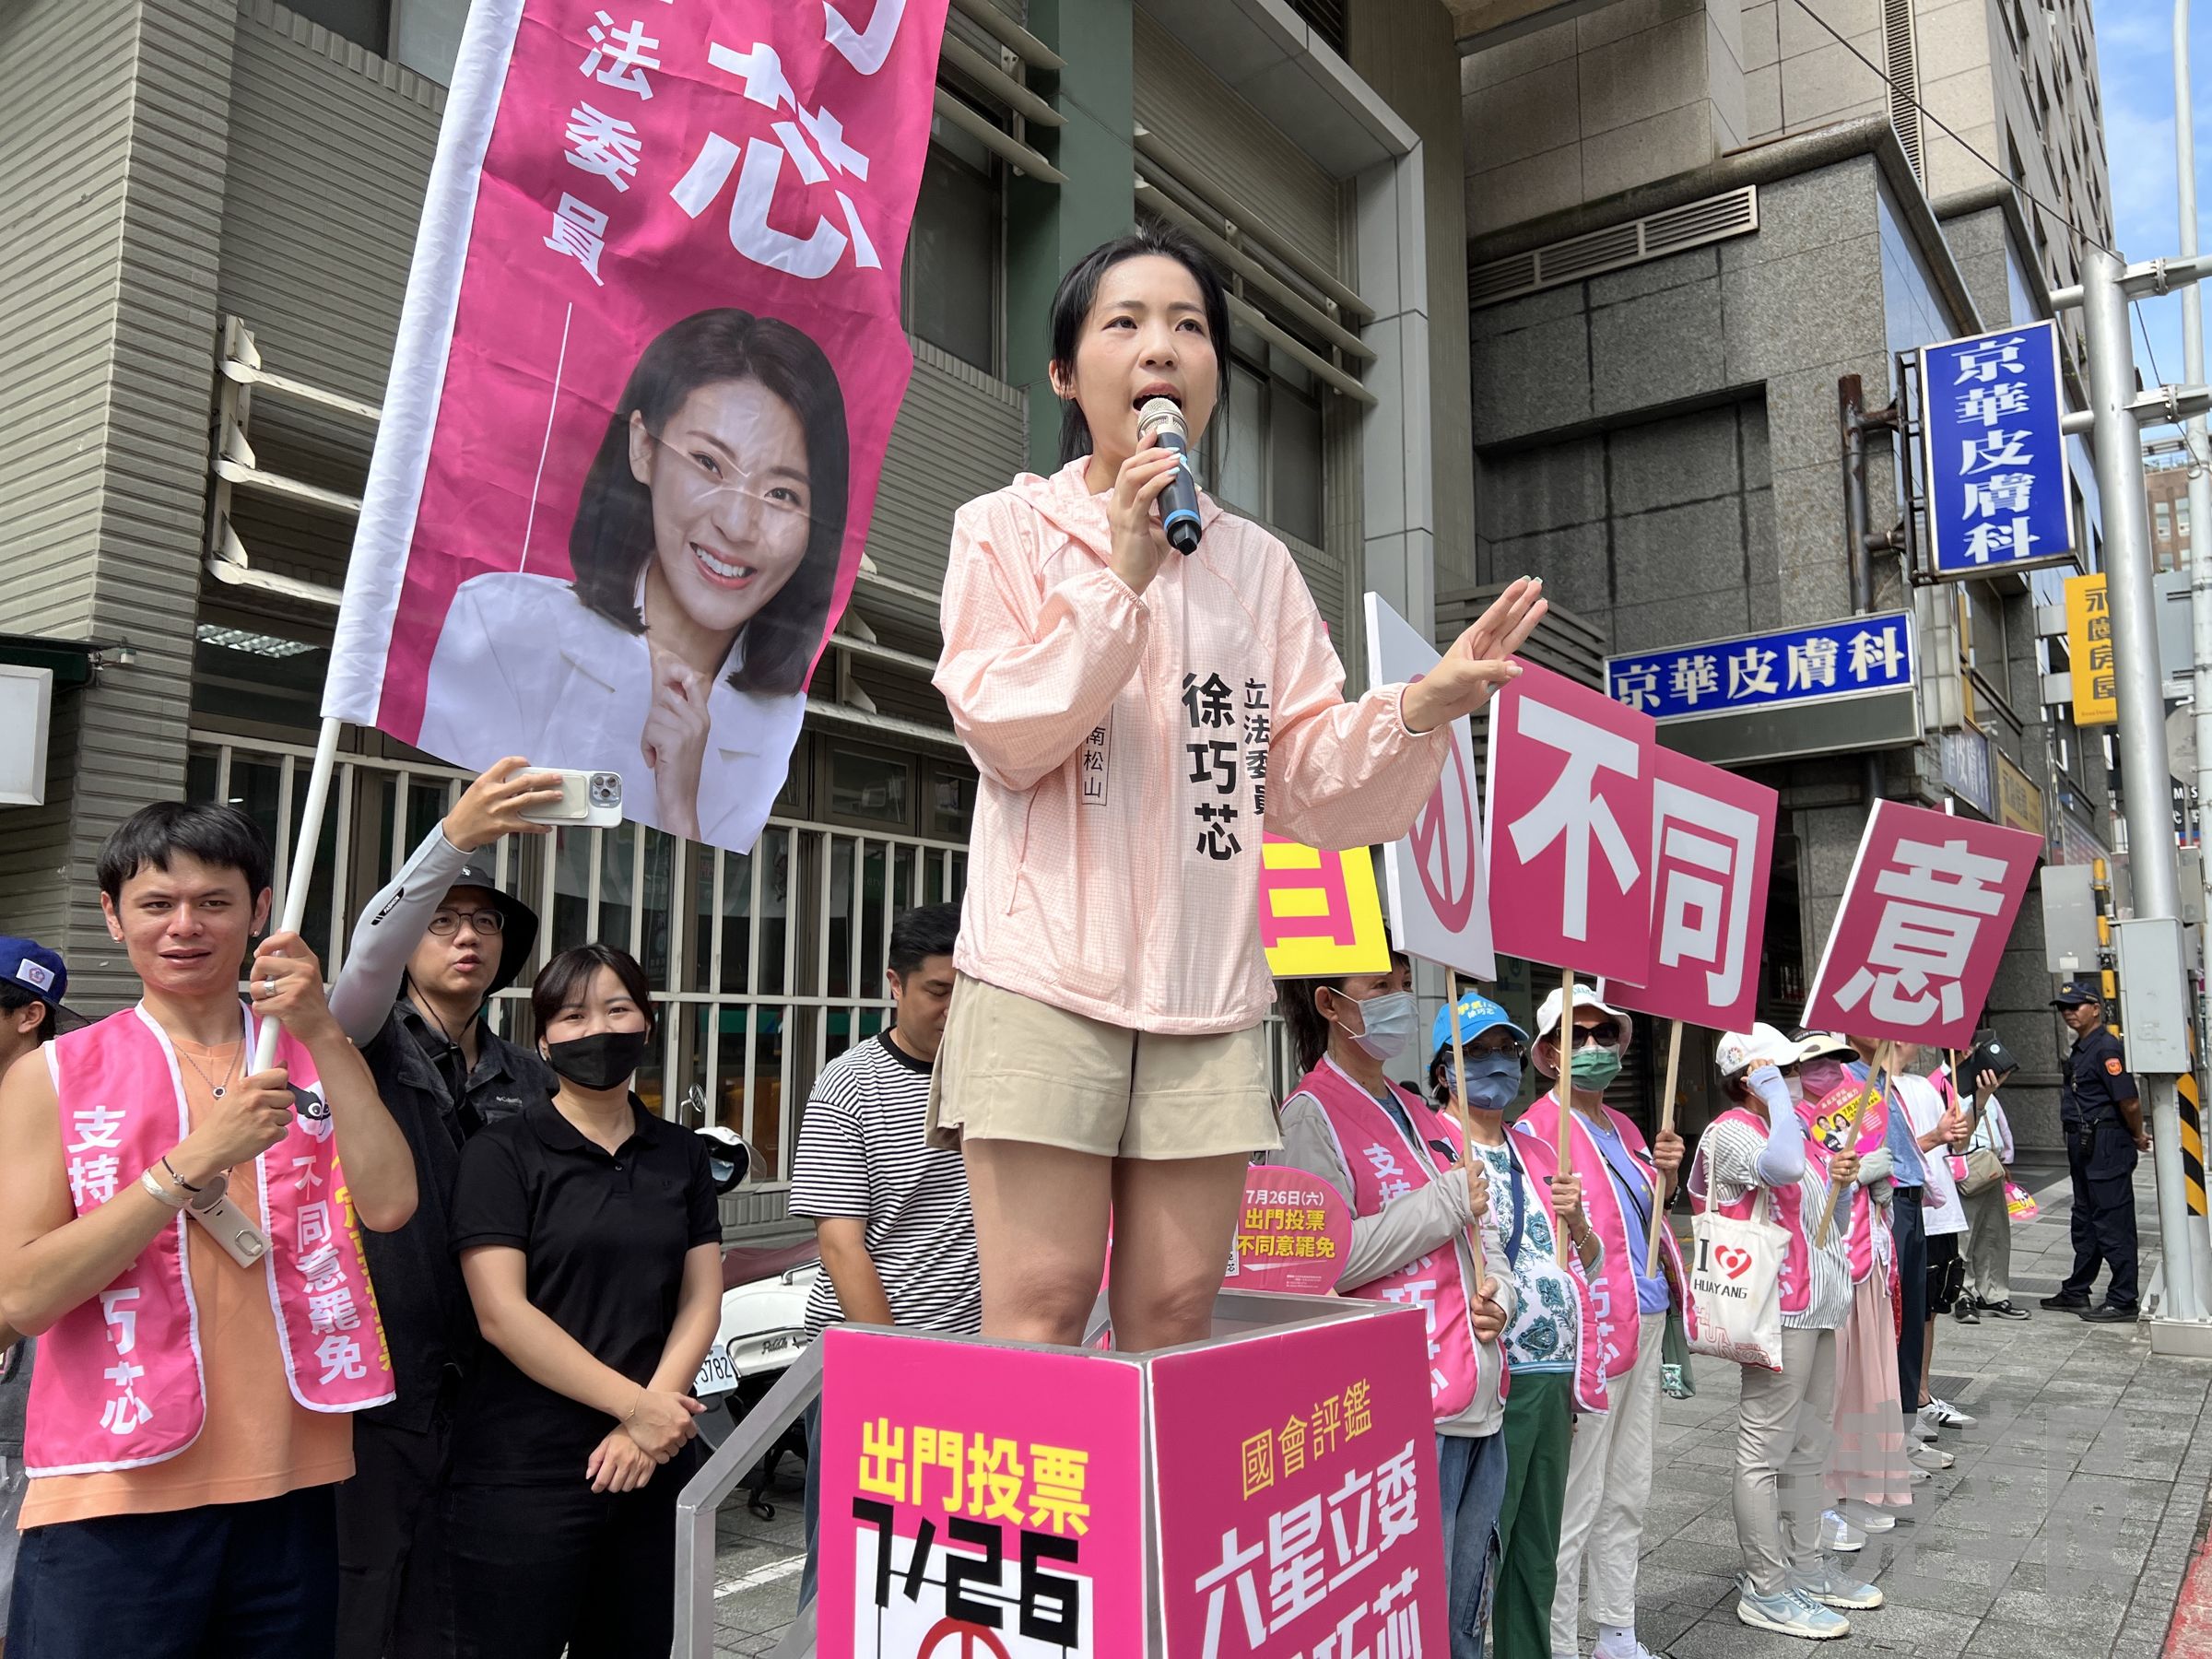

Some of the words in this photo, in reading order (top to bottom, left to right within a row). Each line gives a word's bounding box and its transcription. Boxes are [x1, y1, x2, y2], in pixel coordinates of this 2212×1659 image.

[544, 0, 673, 286] 法委員
[669, 0, 906, 279] 芯
[1951, 336, 2040, 563] 京華皮膚科
[1612, 626, 1904, 711] 京華皮膚科
[1182, 672, 1242, 861] 徐巧芯
[1508, 696, 1641, 942] 不
[1653, 778, 1761, 1008] 同
[1832, 839, 2010, 1028] 意
[292, 1155, 367, 1384] 不同意罷免
[1237, 1235, 1335, 1258] 不同意罷免
[1245, 1189, 1324, 1206] 7月26日(六)
[1245, 1208, 1325, 1231] 出門投票
[694, 1357, 733, 1384] 5782
[1241, 1378, 1372, 1501] 國會評鑑
[859, 1418, 1089, 1536] 出門投票
[1195, 1439, 1419, 1659] 六星立委
[853, 1496, 1079, 1650] 7/26
